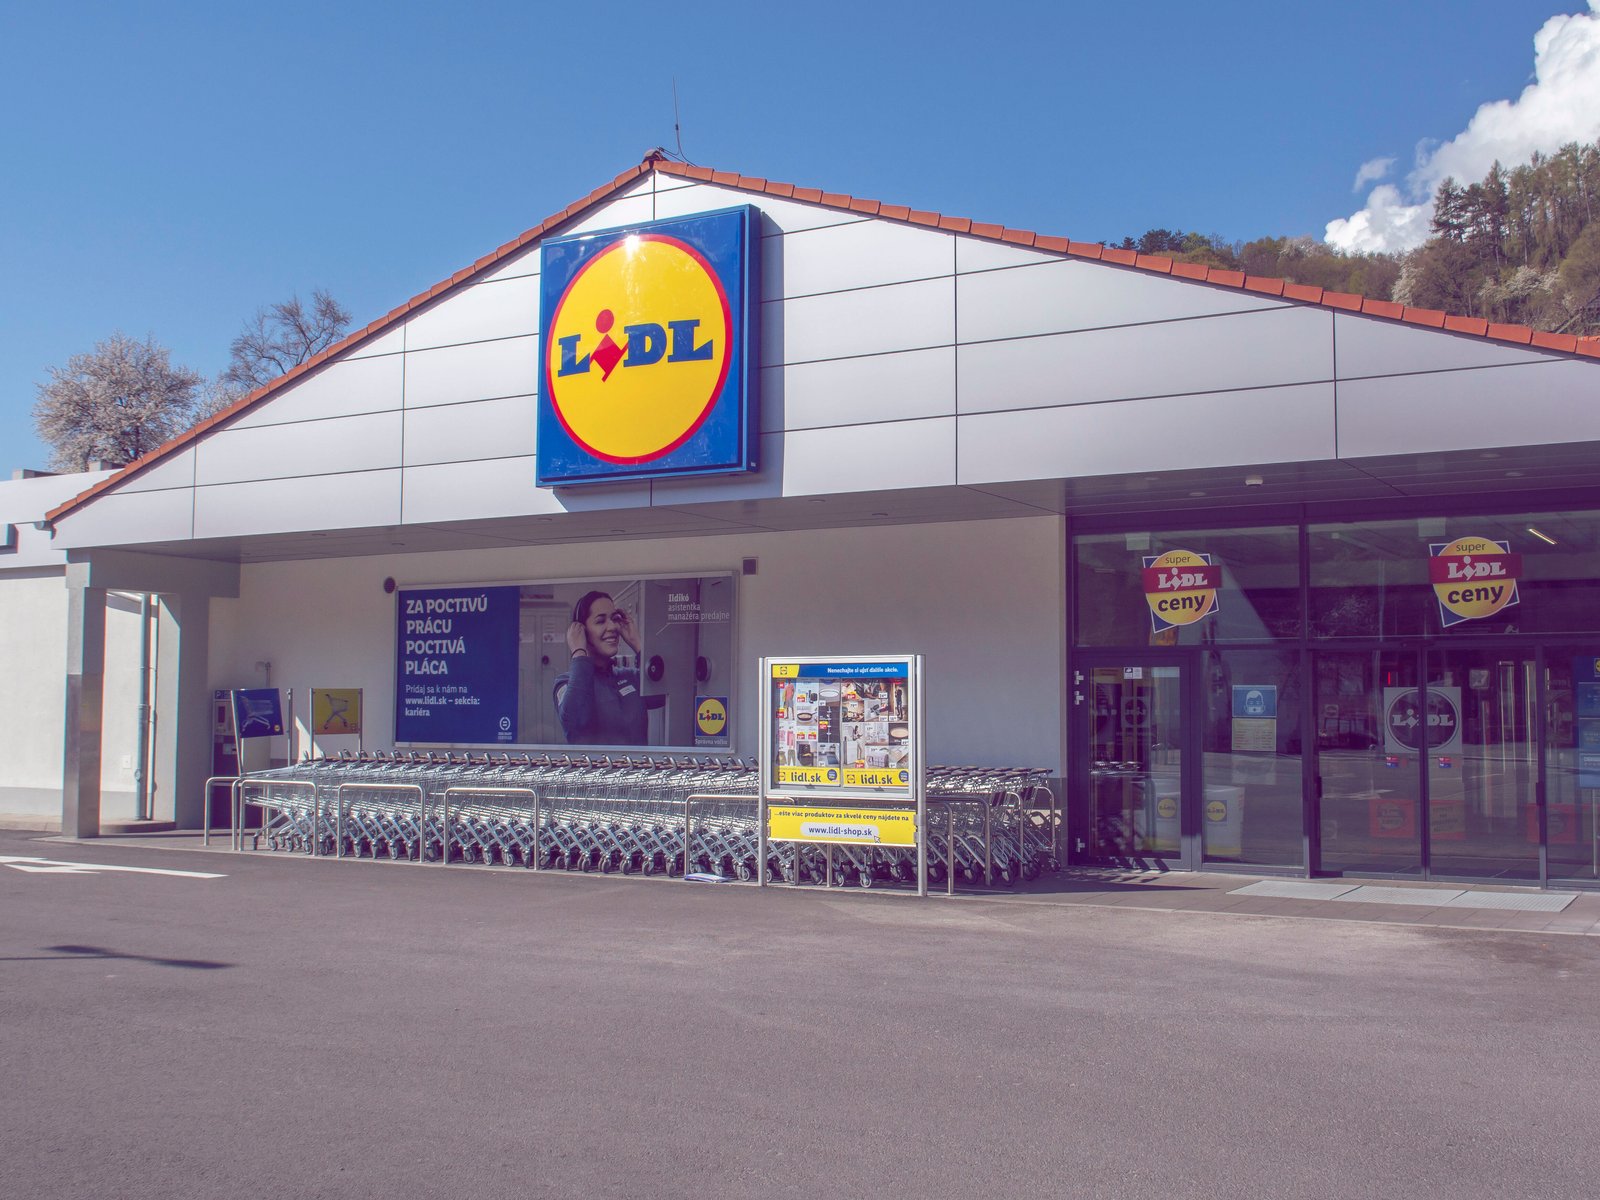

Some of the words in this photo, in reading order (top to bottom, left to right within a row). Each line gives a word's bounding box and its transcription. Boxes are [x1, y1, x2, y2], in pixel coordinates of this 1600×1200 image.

[1456, 543, 1486, 553] super
[1165, 556, 1191, 565] super
[1447, 585, 1504, 604] ceny
[406, 599, 424, 614] ZA
[426, 594, 488, 614] POCTIVÚ
[1158, 595, 1206, 612] ceny
[406, 617, 452, 634] PRÁCU
[406, 636, 466, 654] POCTIVÁ
[405, 657, 448, 675] PLÁCA
[405, 684, 426, 694] Pridaj
[436, 685, 440, 693] k
[442, 685, 457, 693] nám
[405, 696, 447, 705] www.lidl.sk
[454, 696, 480, 705] sekcia:
[405, 707, 430, 716] kariéra
[791, 771, 821, 782] lidl.sk
[861, 774, 893, 785] lidl.sk
[878, 814, 900, 822] nájdete
[808, 826, 872, 837] www.lidl-shop.sk
